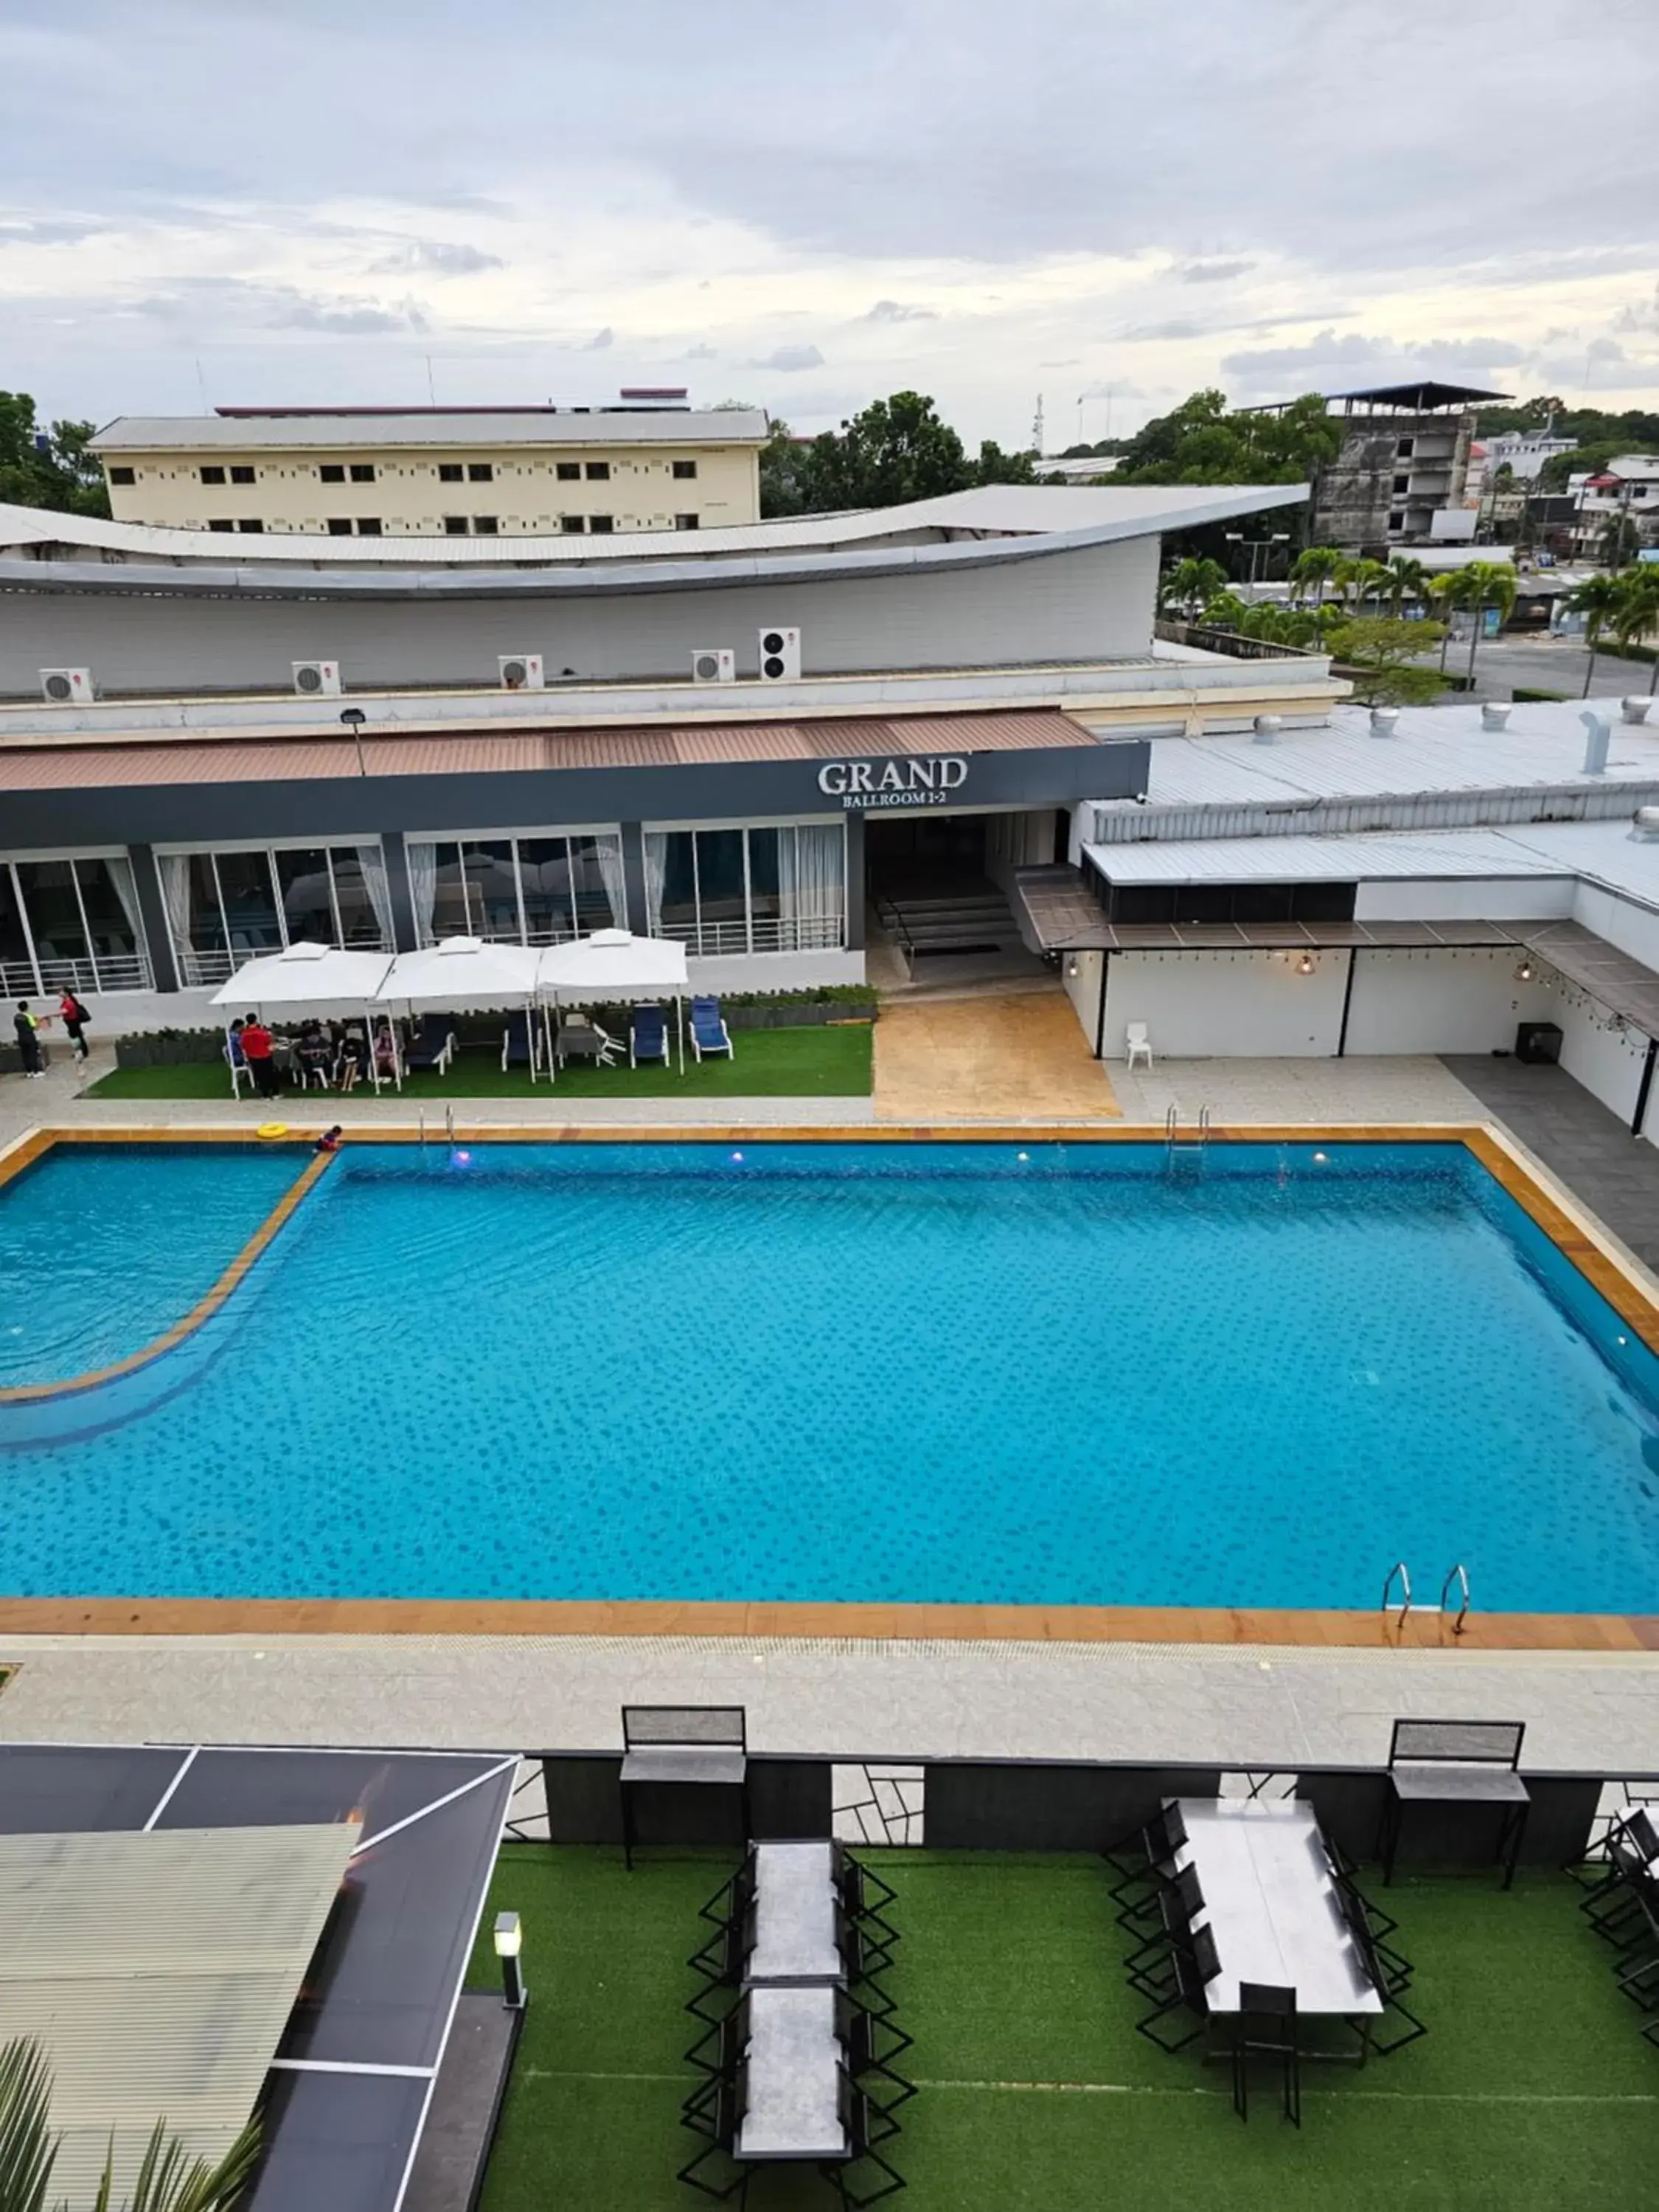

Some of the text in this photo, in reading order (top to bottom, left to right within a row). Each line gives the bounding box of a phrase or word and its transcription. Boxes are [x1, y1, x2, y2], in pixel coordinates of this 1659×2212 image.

[818, 758, 967, 794] GRAND
[843, 791, 946, 807] BALLROOM 1-2
